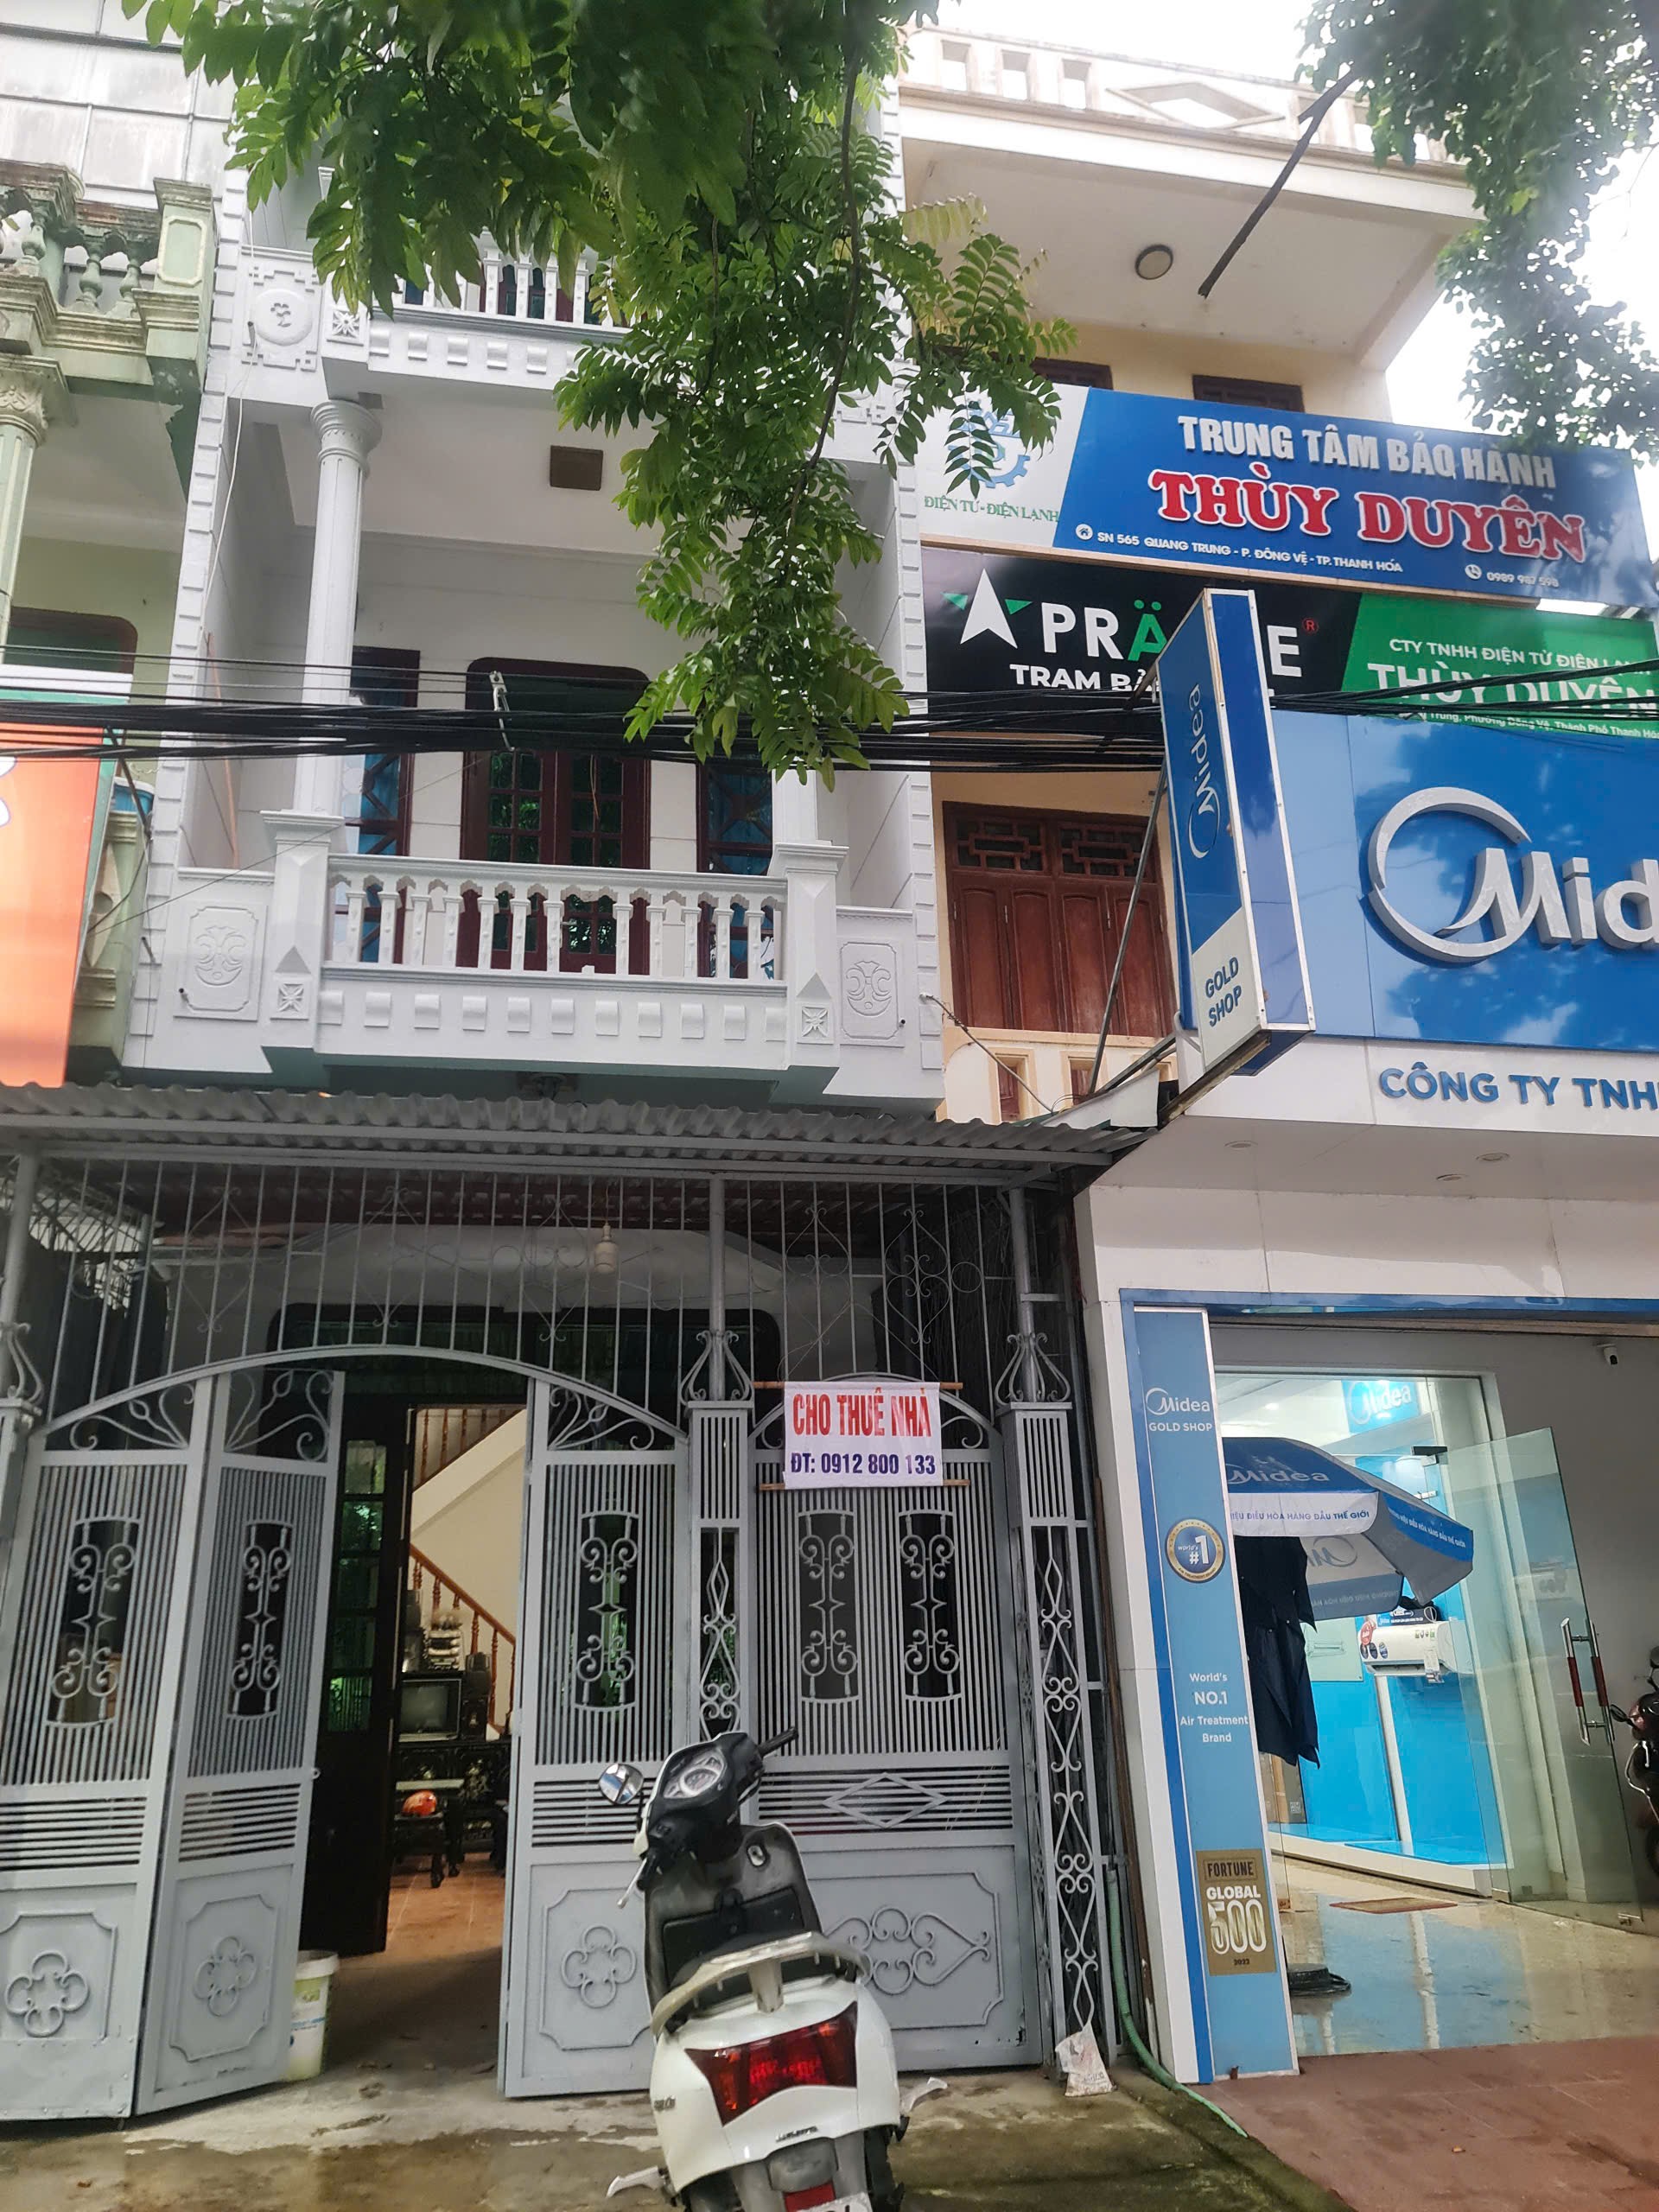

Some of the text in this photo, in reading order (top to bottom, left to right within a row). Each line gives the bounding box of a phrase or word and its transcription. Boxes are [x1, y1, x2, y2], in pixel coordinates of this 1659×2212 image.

[1178, 416, 1294, 462] TRUNG
[1302, 423, 1380, 471] TÂM
[1148, 461, 1585, 563] THÙY DUYÊN
[1097, 531, 1114, 543] SN
[1116, 534, 1140, 546] 565
[1144, 537, 1189, 551] QUANG
[1192, 542, 1231, 556] TRUNG
[1241, 547, 1252, 558] P.
[1255, 546, 1290, 563] ĐÔNG
[1293, 550, 1308, 567] VỆ
[1333, 556, 1374, 570] THANH
[1389, 639, 1422, 654] CTY
[1427, 641, 1478, 660] TNHH
[1482, 646, 1525, 665] ĐIỆN
[1529, 649, 1553, 666] TỬ
[1187, 683, 1221, 860] Midea
[1205, 956, 1239, 1000] GOLD
[1208, 983, 1243, 1028] SHOP
[1379, 1061, 1659, 1110] CÔNG TY TNH
[792, 1386, 931, 1437] CHO THUÊ NHÀ
[1146, 1387, 1211, 1416] Midea
[1148, 1421, 1213, 1433] GOLD SHOP
[791, 1452, 936, 1475] ĐT: 0912 800 133
[1225, 1463, 1331, 1485] Midea
[1189, 1672, 1228, 1682] World's
[1194, 1690, 1228, 1706] NO.1
[1179, 1715, 1249, 1726] Air Treatment
[1202, 1732, 1232, 1744] Brand
[1206, 1860, 1255, 1878] FORTUNE
[1206, 1885, 1262, 1900] GLOBAL
[1207, 1898, 1268, 1955] 500
